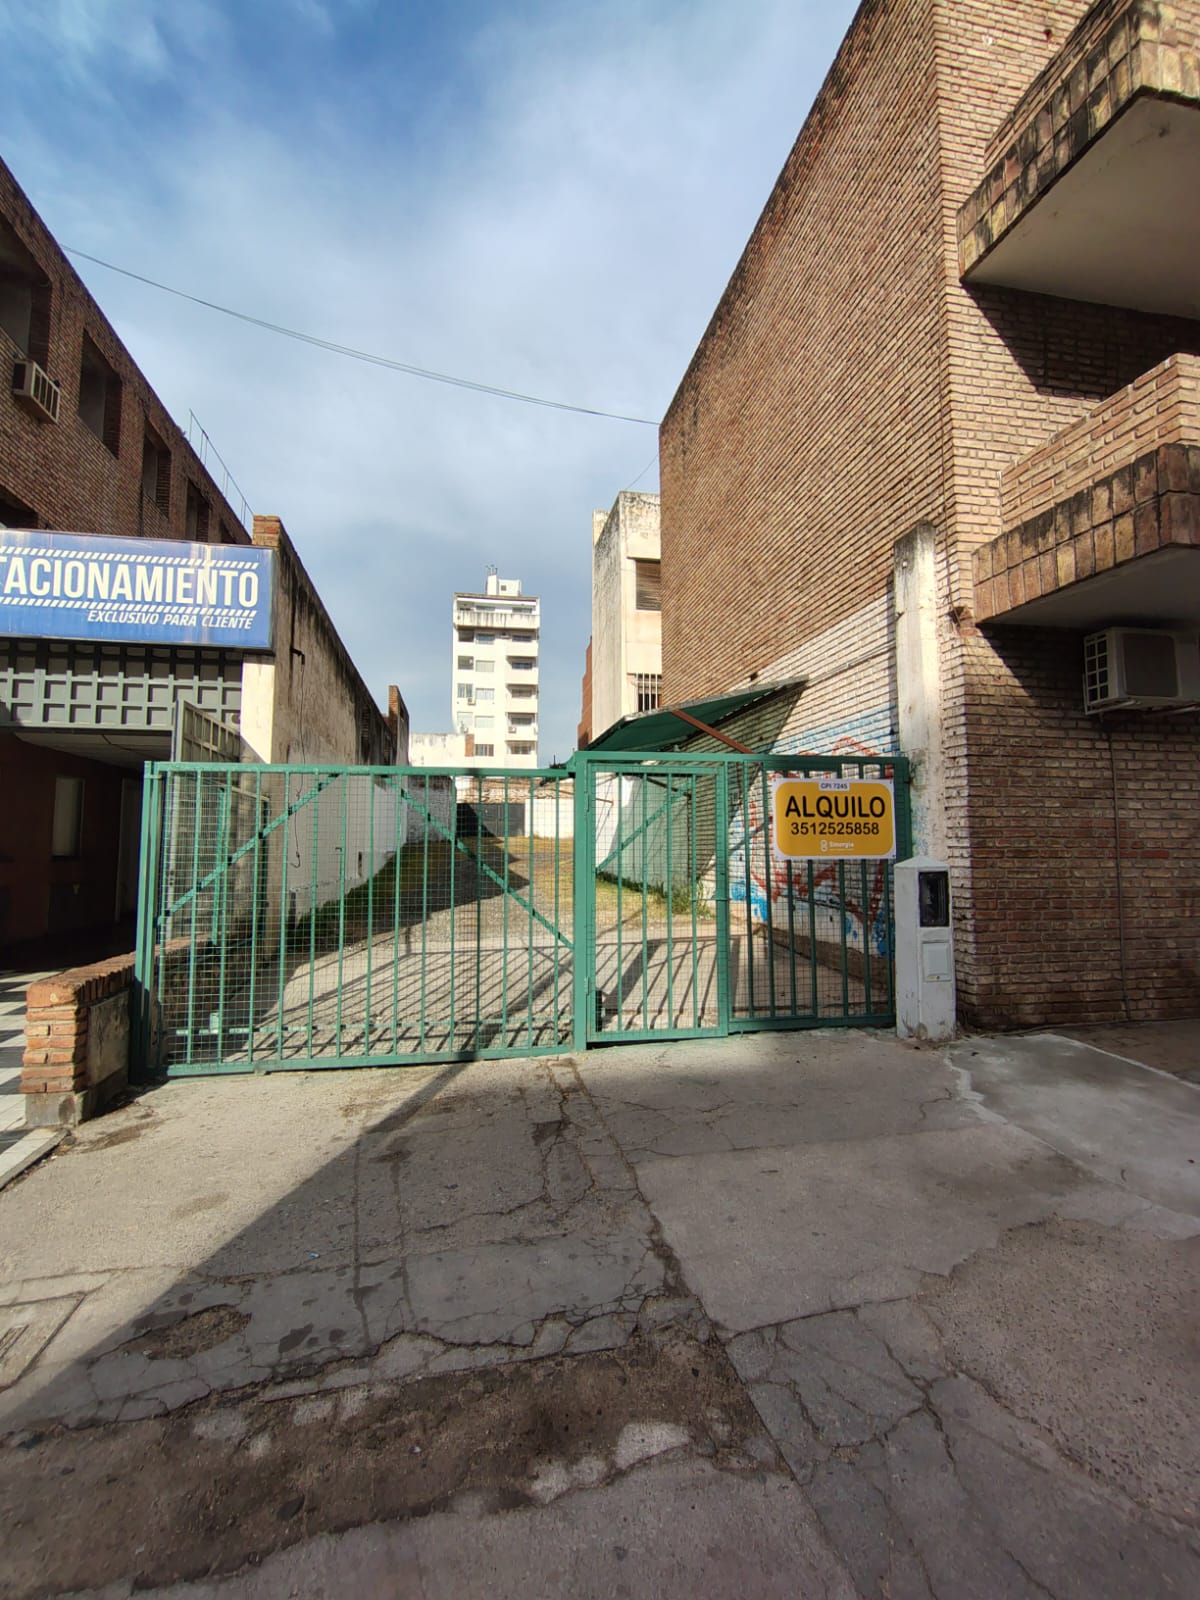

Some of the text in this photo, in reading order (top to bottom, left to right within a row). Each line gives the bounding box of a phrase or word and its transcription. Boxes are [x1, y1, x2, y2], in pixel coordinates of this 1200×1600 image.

[87, 610, 253, 630] EXCLUSIVO PARA CLIENTE
[785, 795, 886, 819] ALQUILO
[790, 822, 880, 836] 3512525858
